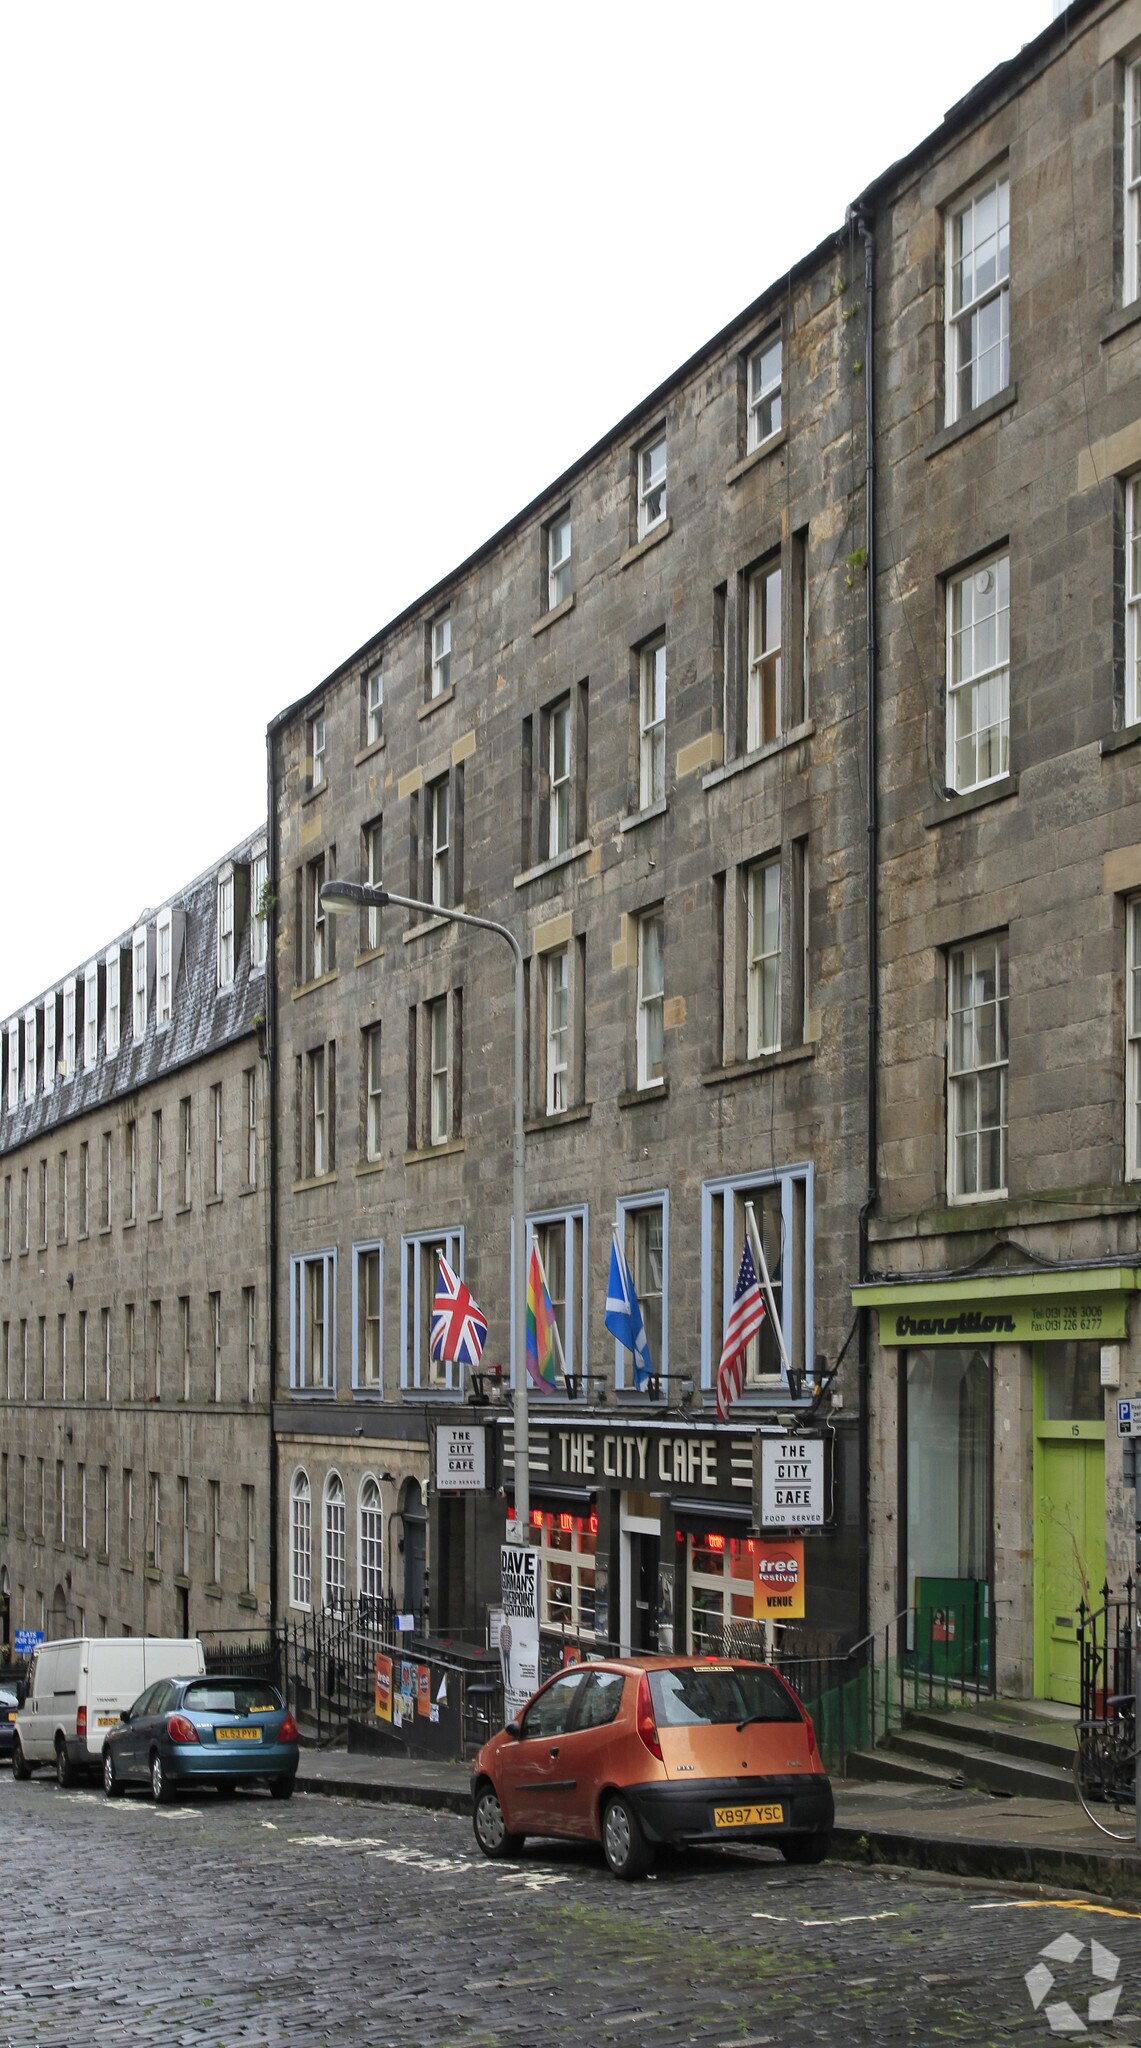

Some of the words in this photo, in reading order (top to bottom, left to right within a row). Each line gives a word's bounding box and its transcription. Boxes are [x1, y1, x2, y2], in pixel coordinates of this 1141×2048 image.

[1032, 1308, 1044, 1319] Tel:
[1045, 1307, 1060, 1319] 0131
[1063, 1306, 1077, 1318] 226
[1080, 1306, 1102, 1318] 3006
[1031, 1320, 1044, 1331] Fax:
[1045, 1320, 1060, 1331] 0131
[1063, 1319, 1077, 1331] 226
[1080, 1319, 1102, 1330] 6277
[452, 1431, 471, 1440] THE
[1071, 1425, 1080, 1437] 15
[450, 1445, 472, 1454] CITY
[781, 1445, 805, 1457] THE
[559, 1432, 595, 1475] THE
[603, 1435, 649, 1480] CITY
[658, 1438, 718, 1486] CAFE
[448, 1461, 474, 1470] CAFE
[778, 1465, 808, 1478] CITY
[776, 1490, 810, 1504] CAFE
[792, 1514, 821, 1522] SERVED
[502, 1550, 535, 1575] DAVE
[759, 1560, 798, 1573] free
[759, 1573, 798, 1583] festival
[766, 1596, 793, 1608] VENUE
[717, 1809, 751, 1825] X897
[756, 1806, 781, 1821] YSC
